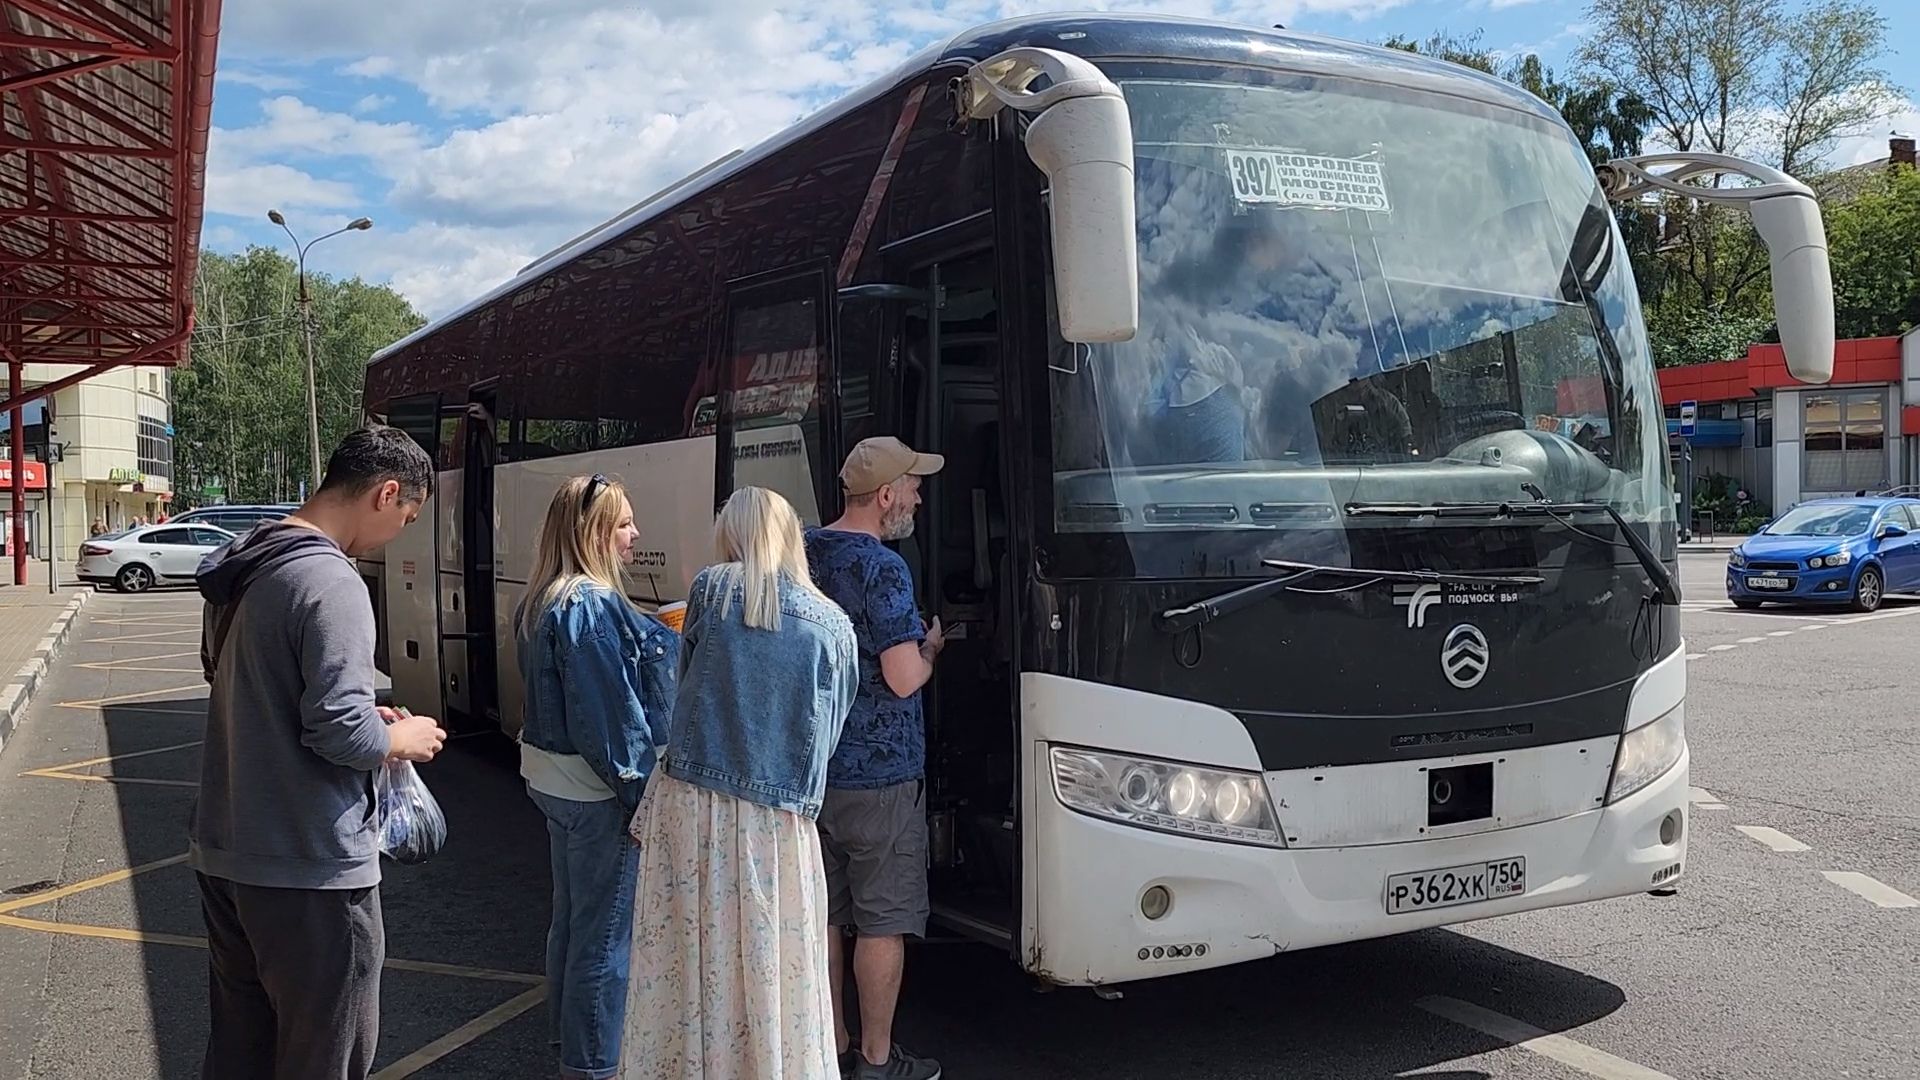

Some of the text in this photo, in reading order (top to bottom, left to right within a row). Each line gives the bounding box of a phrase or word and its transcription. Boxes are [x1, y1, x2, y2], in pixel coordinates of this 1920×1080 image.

[1275, 155, 1378, 174] КОРОЛЕВ
[1232, 155, 1277, 196] 392
[1303, 169, 1381, 186] СИЛИКАТНАЯ)
[1281, 177, 1383, 195] МОСКВА
[1319, 190, 1385, 208] ВДНХ)
[1448, 593, 1519, 605] ПОДМОСКВЬЯ
[1395, 861, 1520, 909] Р362ХК 750
[1495, 884, 1511, 894] RUS
